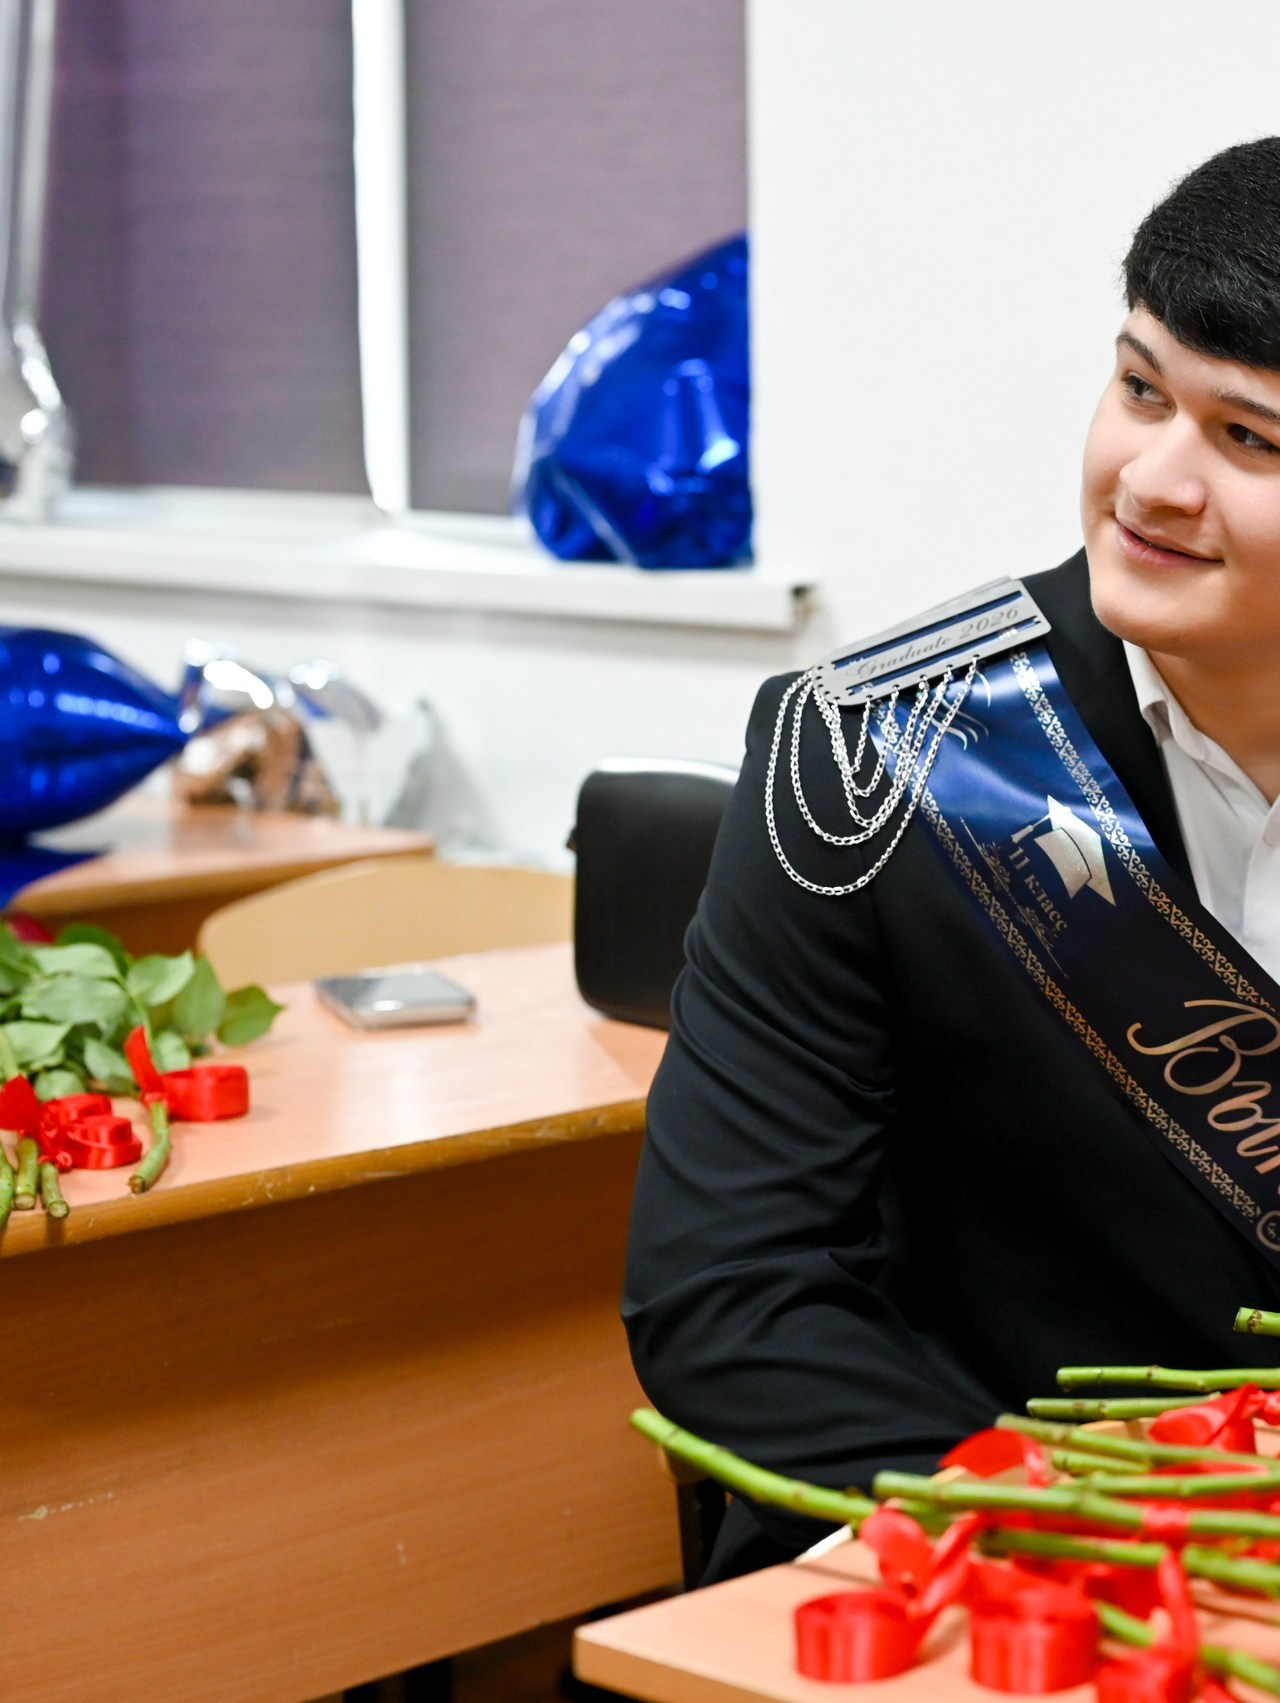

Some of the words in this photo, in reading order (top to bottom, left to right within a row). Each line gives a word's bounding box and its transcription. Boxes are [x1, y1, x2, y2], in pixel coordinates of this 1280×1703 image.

[849, 636, 951, 679] Graduate
[959, 606, 1019, 640] 2026
[1008, 847, 1030, 870] 11
[1024, 874, 1067, 931] класс
